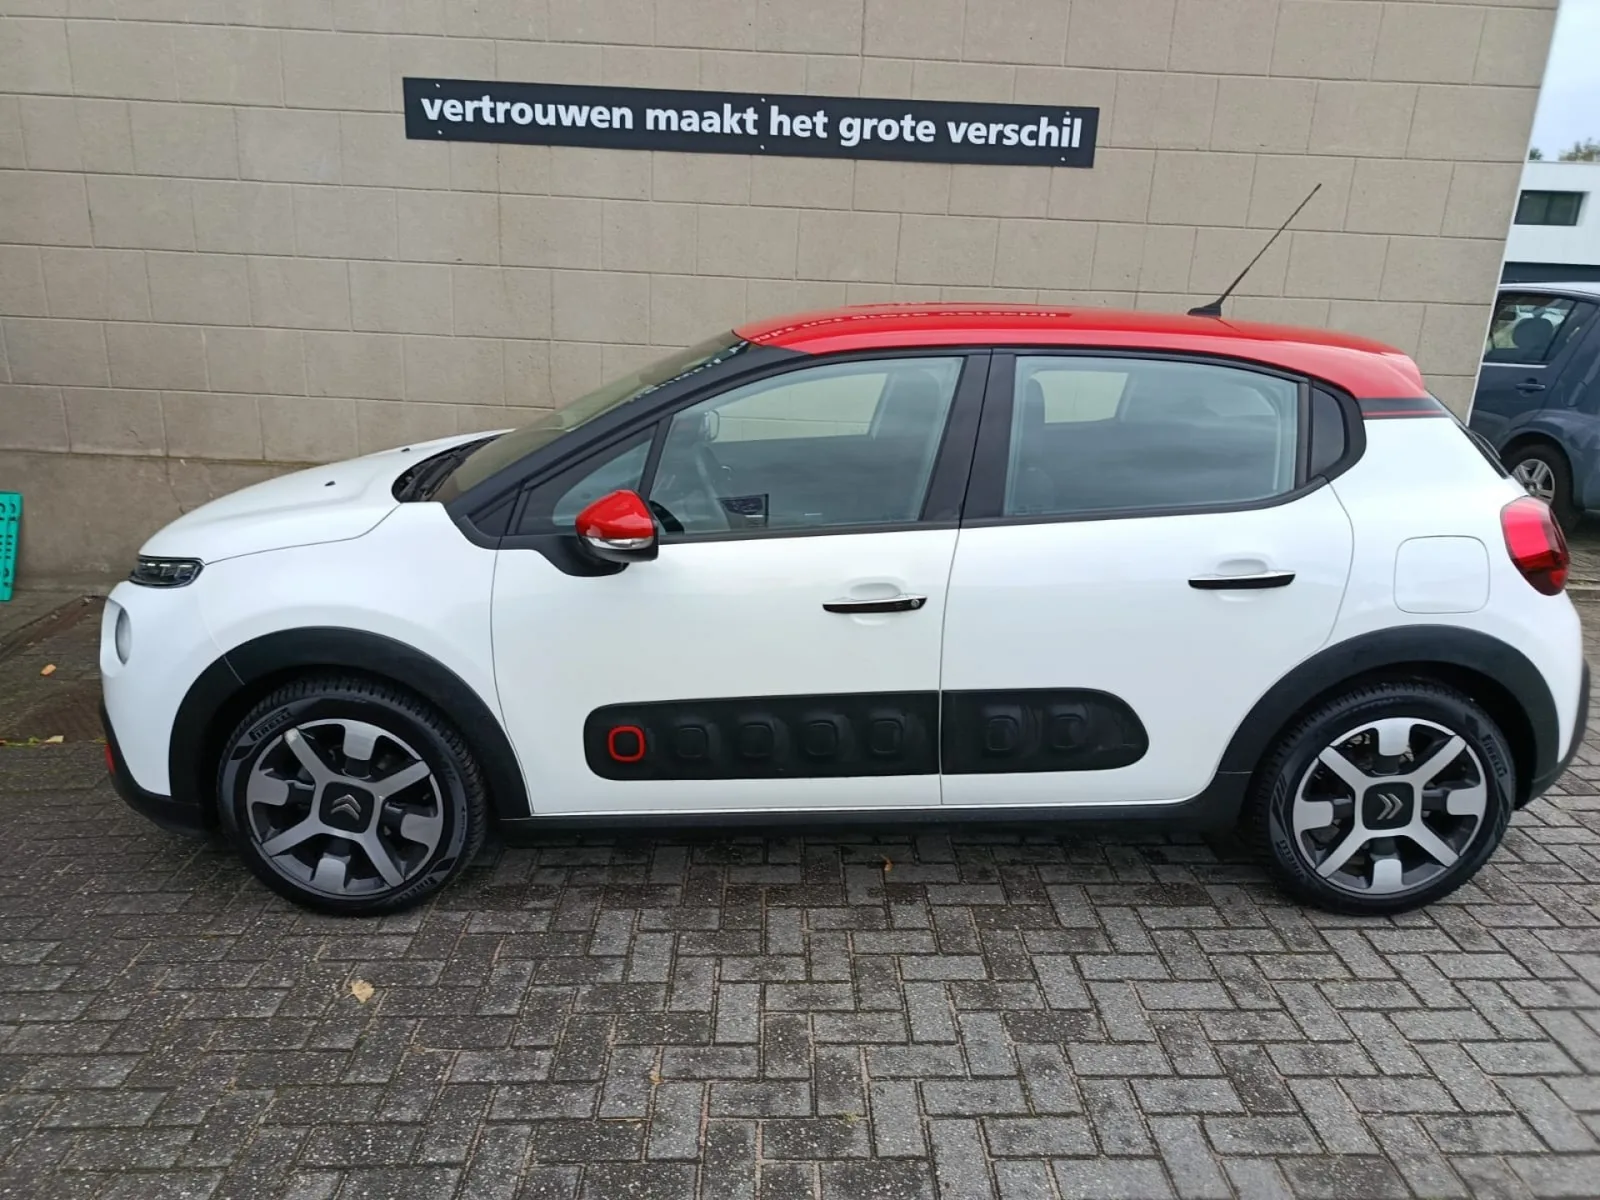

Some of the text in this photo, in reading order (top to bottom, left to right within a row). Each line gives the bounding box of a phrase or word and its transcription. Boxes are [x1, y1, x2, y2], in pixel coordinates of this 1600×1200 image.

[420, 94, 1083, 149] vertrouwen maakt het grote verschil
